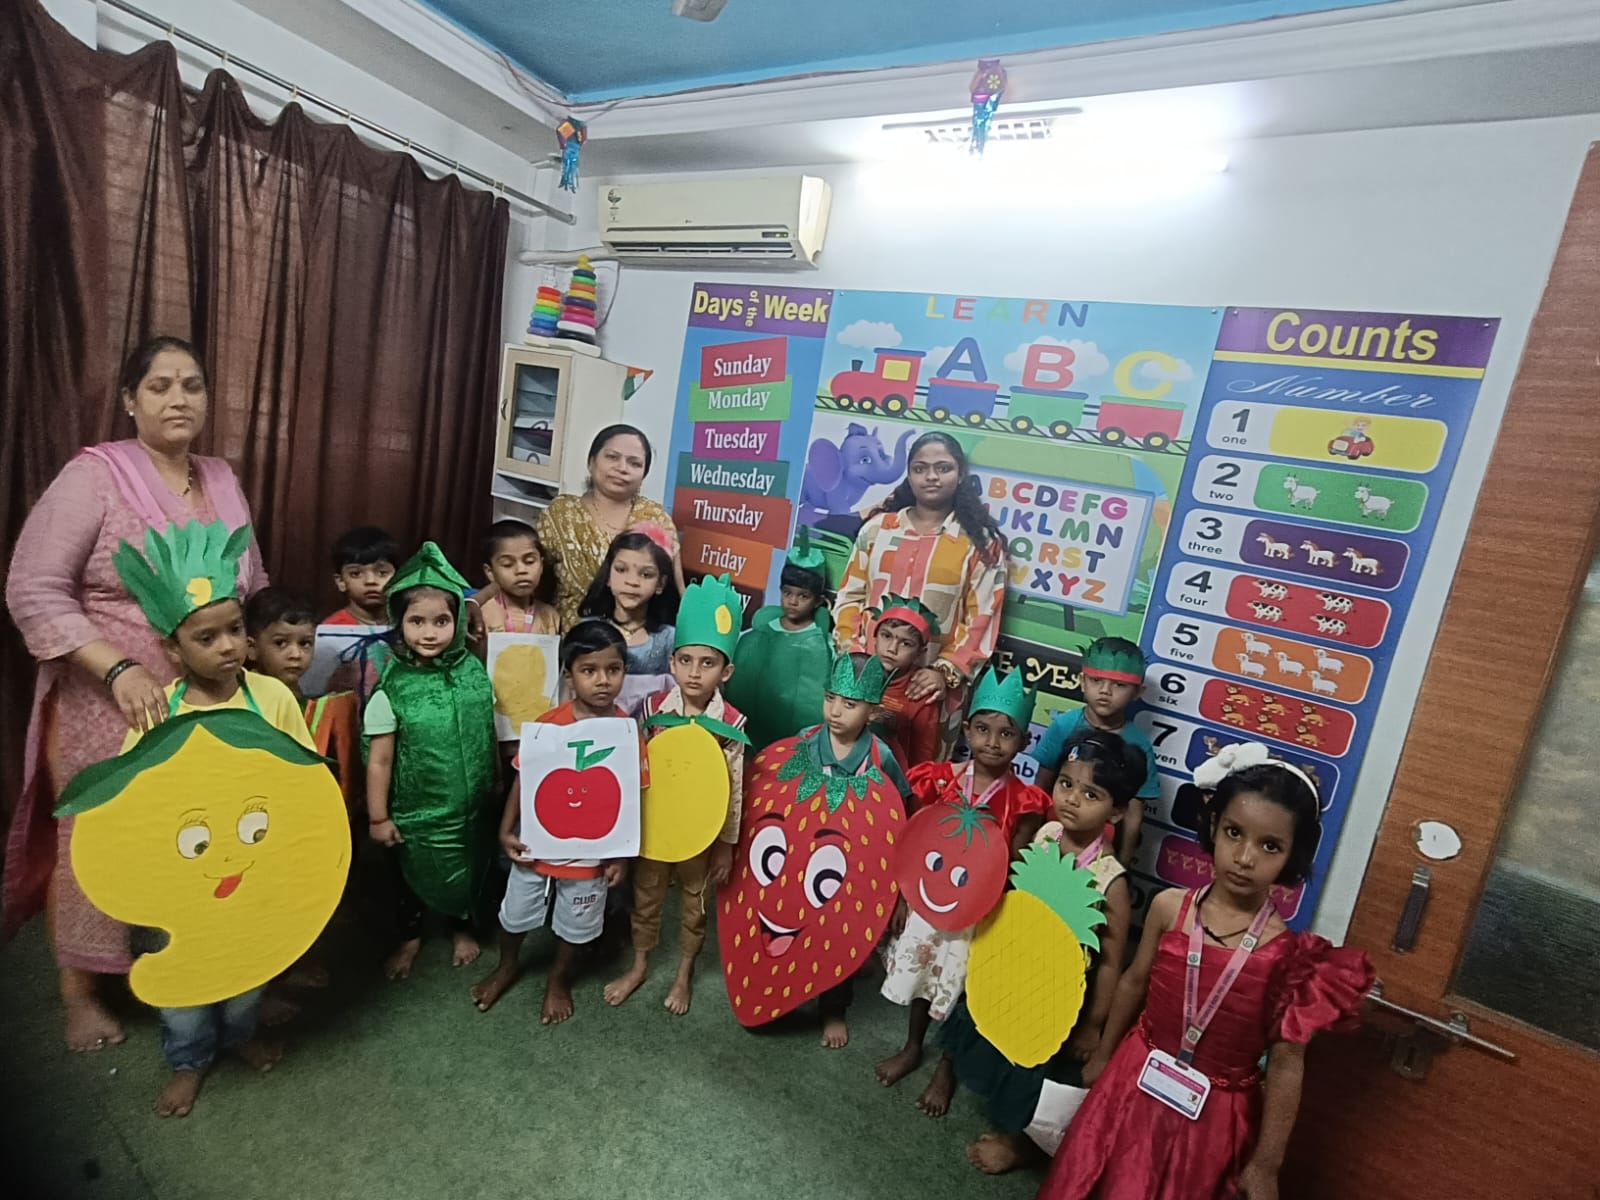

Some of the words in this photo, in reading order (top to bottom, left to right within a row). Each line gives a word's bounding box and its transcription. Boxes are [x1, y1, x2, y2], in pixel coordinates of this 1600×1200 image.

[694, 290, 744, 321] Days
[764, 295, 828, 322] Week
[926, 296, 1088, 327] LEARN
[1266, 311, 1439, 361] Counts
[713, 354, 773, 378] Sunday
[708, 387, 771, 411] Monday
[1227, 375, 1436, 408] Number
[1231, 408, 1251, 433] 1
[704, 427, 768, 454] Tuesday
[1221, 434, 1248, 446] one
[690, 463, 776, 496] Wednesday
[1212, 462, 1242, 488] 2
[1209, 490, 1234, 502] two
[693, 499, 765, 532] Thursday
[1196, 516, 1223, 541] 3
[700, 543, 748, 577] Friday
[1187, 541, 1224, 555] three
[1184, 570, 1213, 594] 4
[1179, 593, 1209, 608] four
[1172, 622, 1200, 646] 5
[1169, 647, 1195, 661] five
[1160, 672, 1188, 695] 6
[1158, 695, 1179, 706] six
[1151, 721, 1177, 747] 7
[1154, 752, 1177, 766] ven
